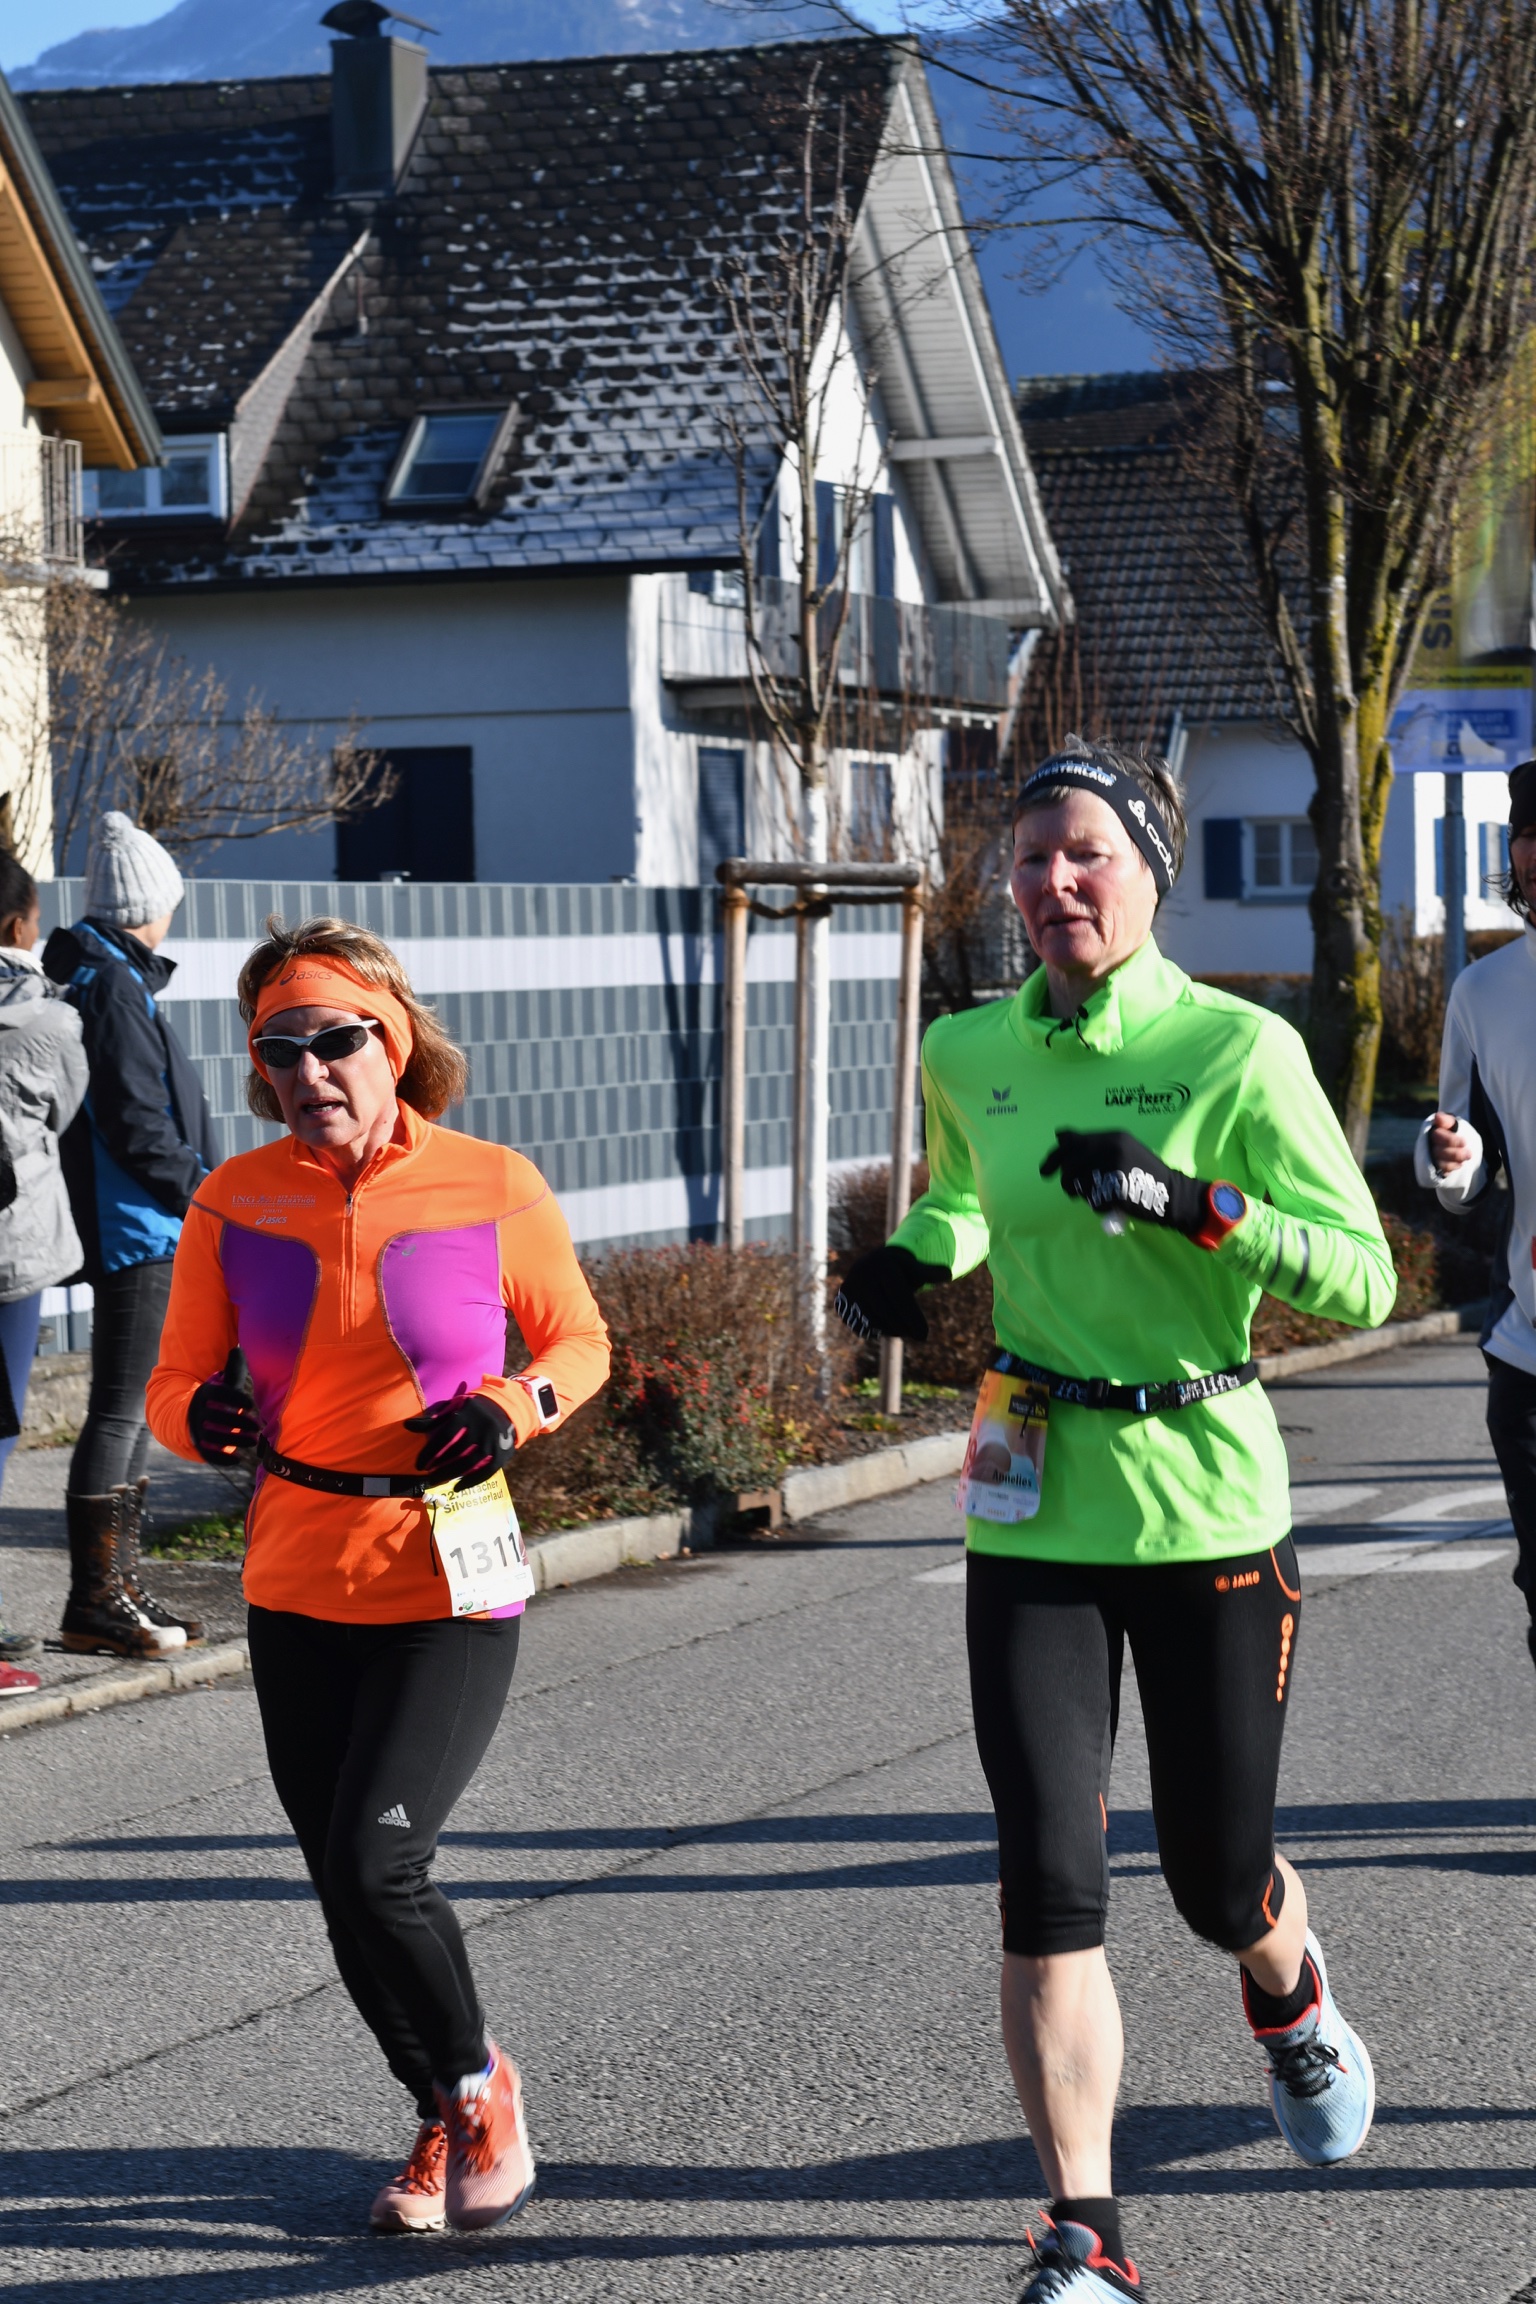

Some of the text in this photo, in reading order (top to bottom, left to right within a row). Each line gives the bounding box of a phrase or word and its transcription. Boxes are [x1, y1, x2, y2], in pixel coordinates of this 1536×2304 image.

[296, 970, 333, 980] asics
[986, 1104, 1018, 1116] erima
[232, 1195, 255, 1203] ING
[265, 1216, 287, 1224] asics
[443, 1489, 504, 1513] Silvesterlauf
[449, 1531, 521, 1579] 1311
[1232, 1570, 1260, 1589] JAKO
[377, 1816, 411, 1828] adidas
